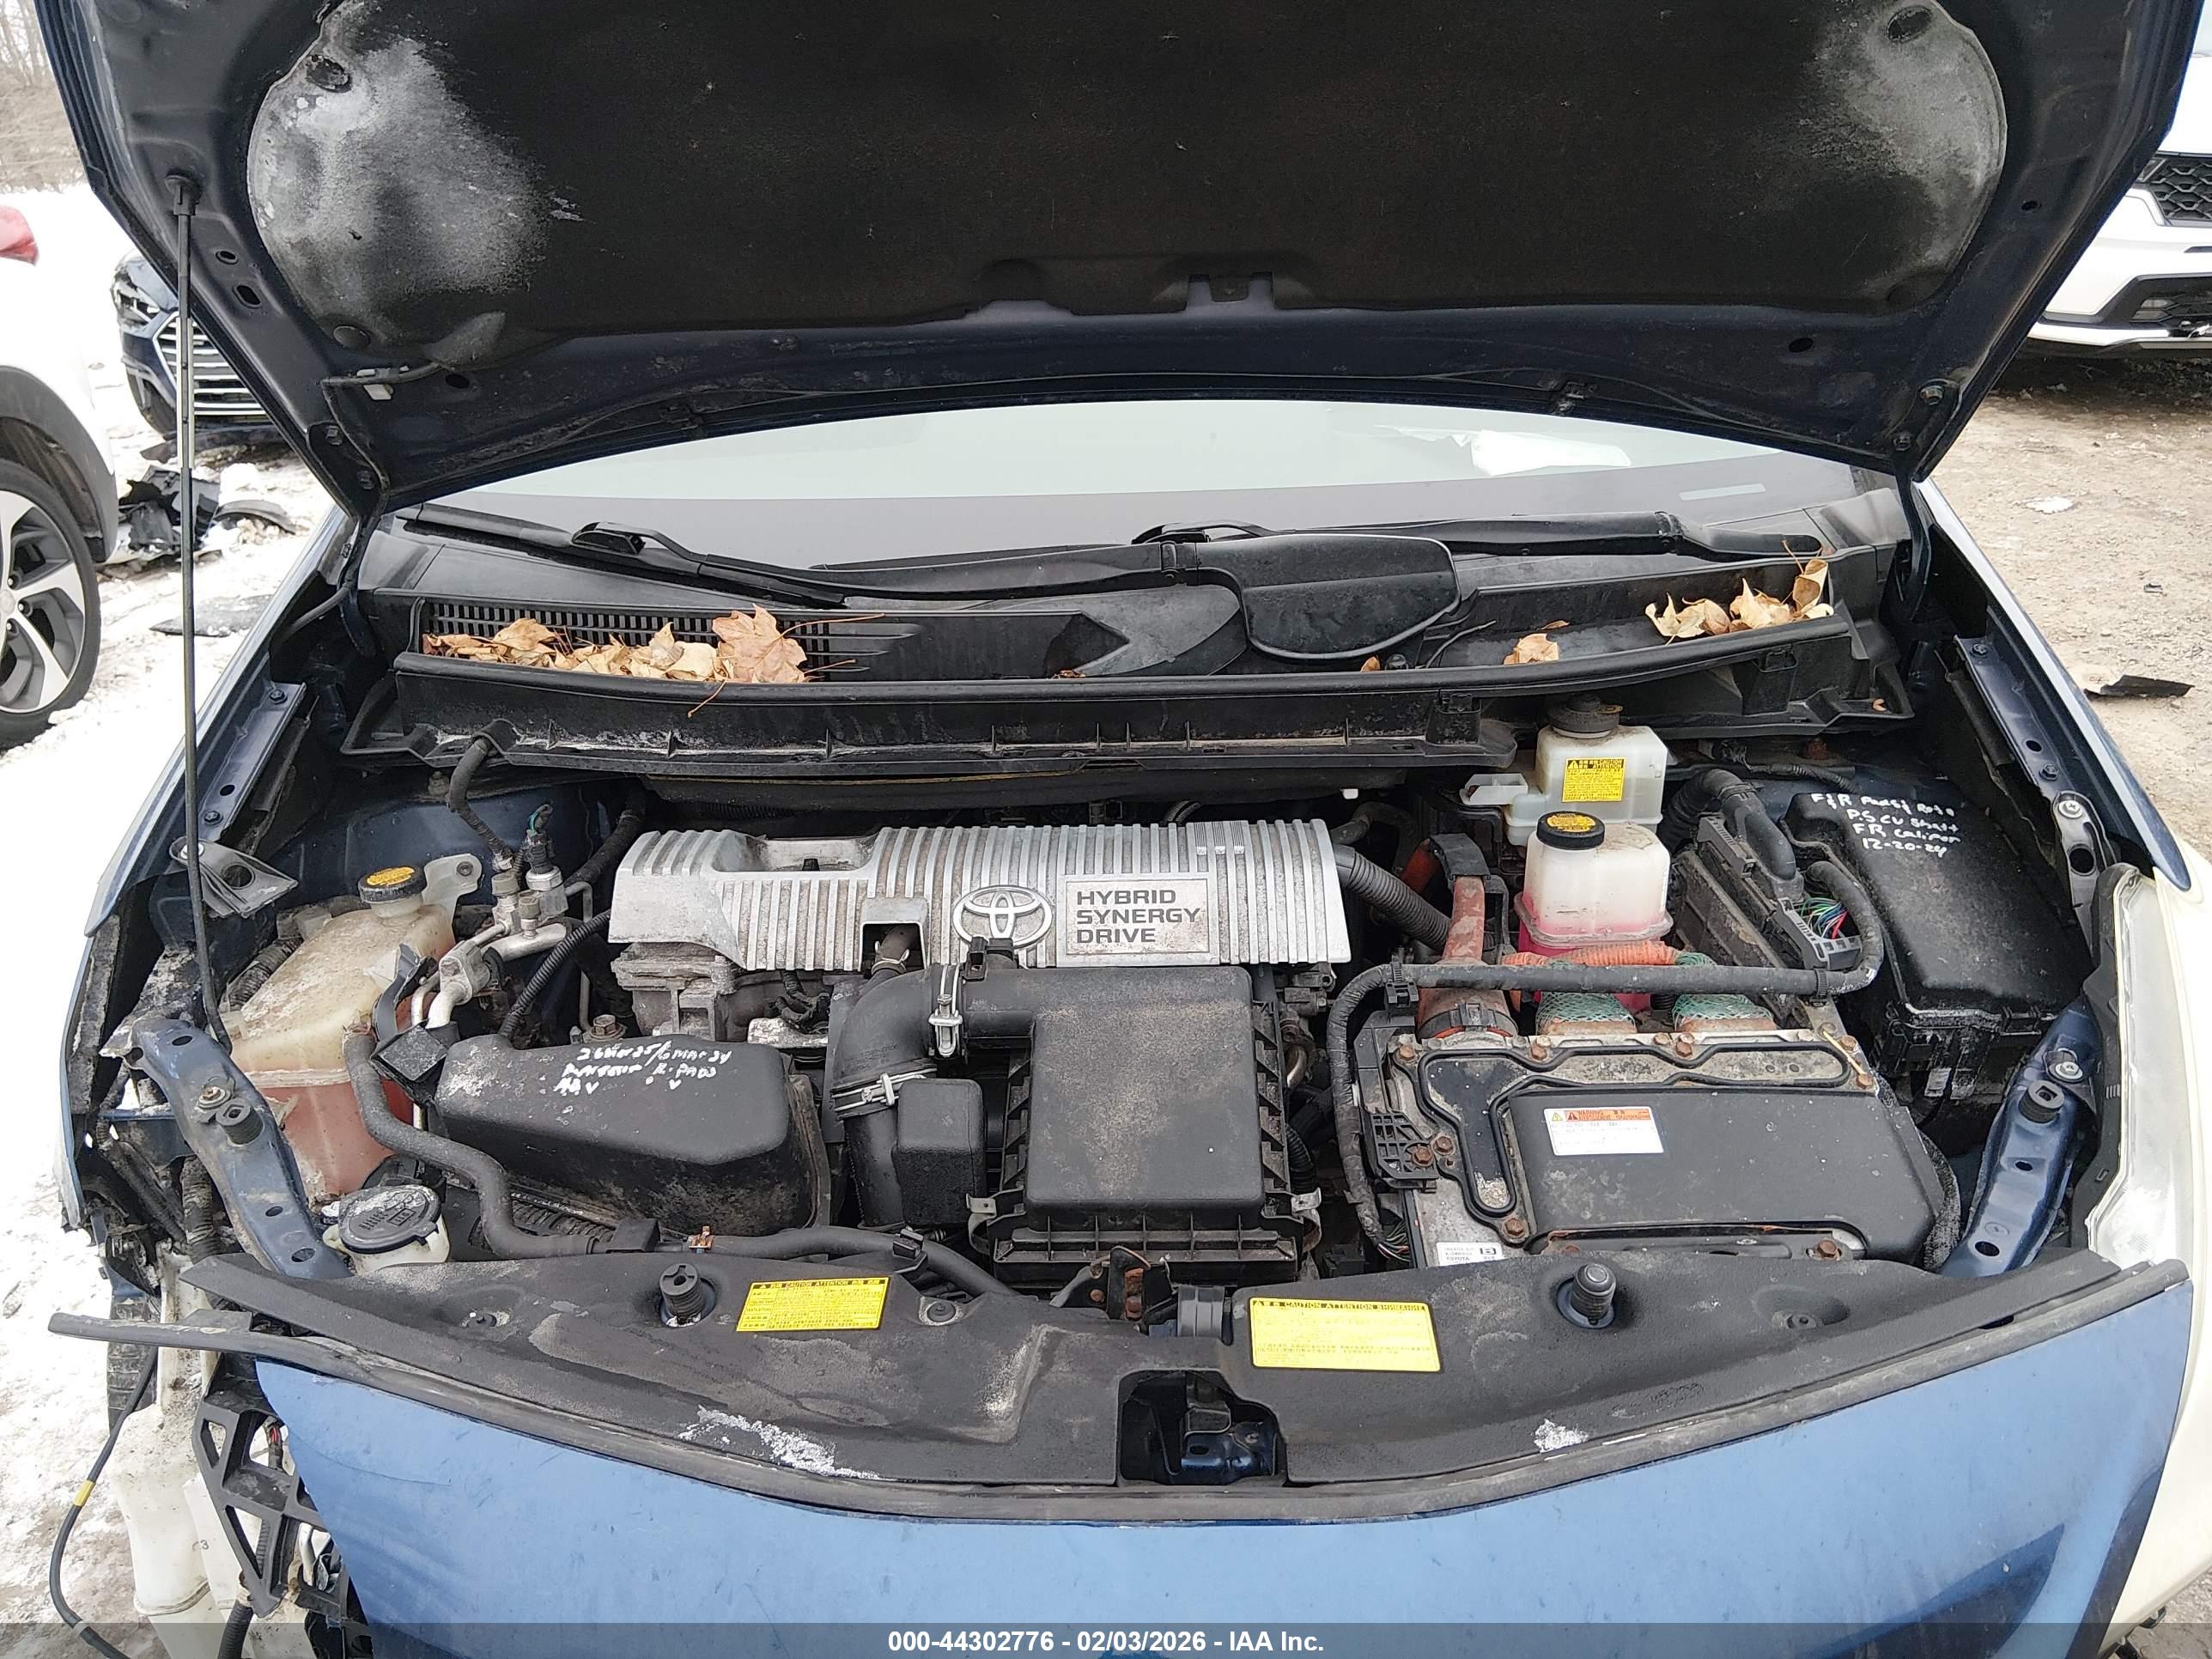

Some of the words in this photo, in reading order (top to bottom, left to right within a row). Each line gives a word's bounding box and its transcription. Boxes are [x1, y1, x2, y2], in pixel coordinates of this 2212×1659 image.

[1077, 890, 1176, 906] HYBRID
[1077, 908, 1201, 925] SYNERGY
[1077, 928, 1156, 944] DRIVE
